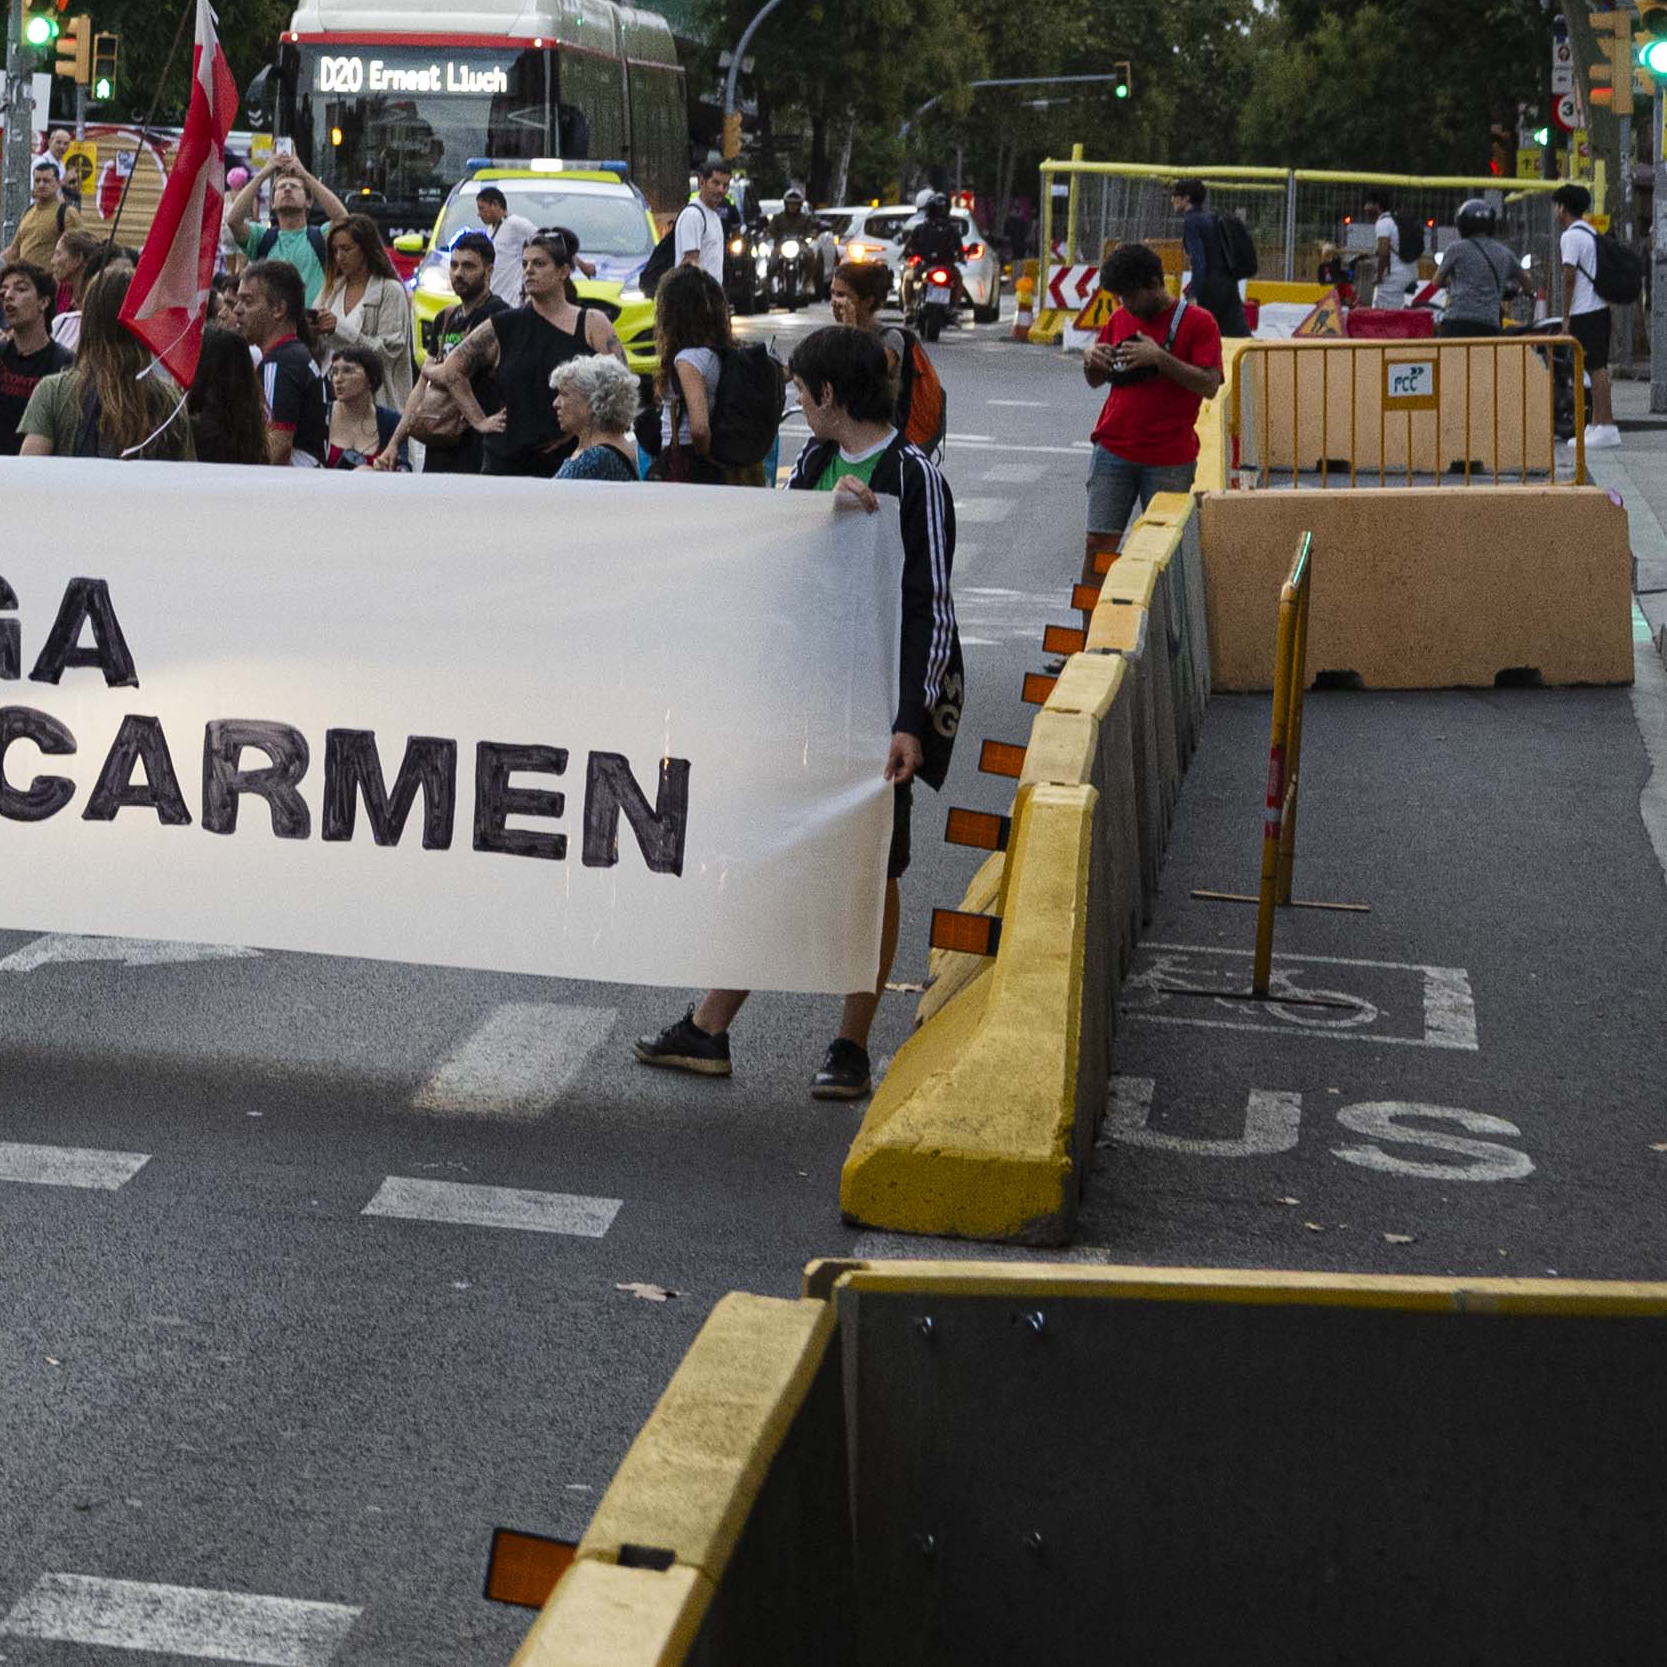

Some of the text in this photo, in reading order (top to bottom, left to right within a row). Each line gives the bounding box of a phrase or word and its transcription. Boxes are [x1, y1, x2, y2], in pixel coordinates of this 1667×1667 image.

[320, 56, 507, 92] D20 Ernest Lluch
